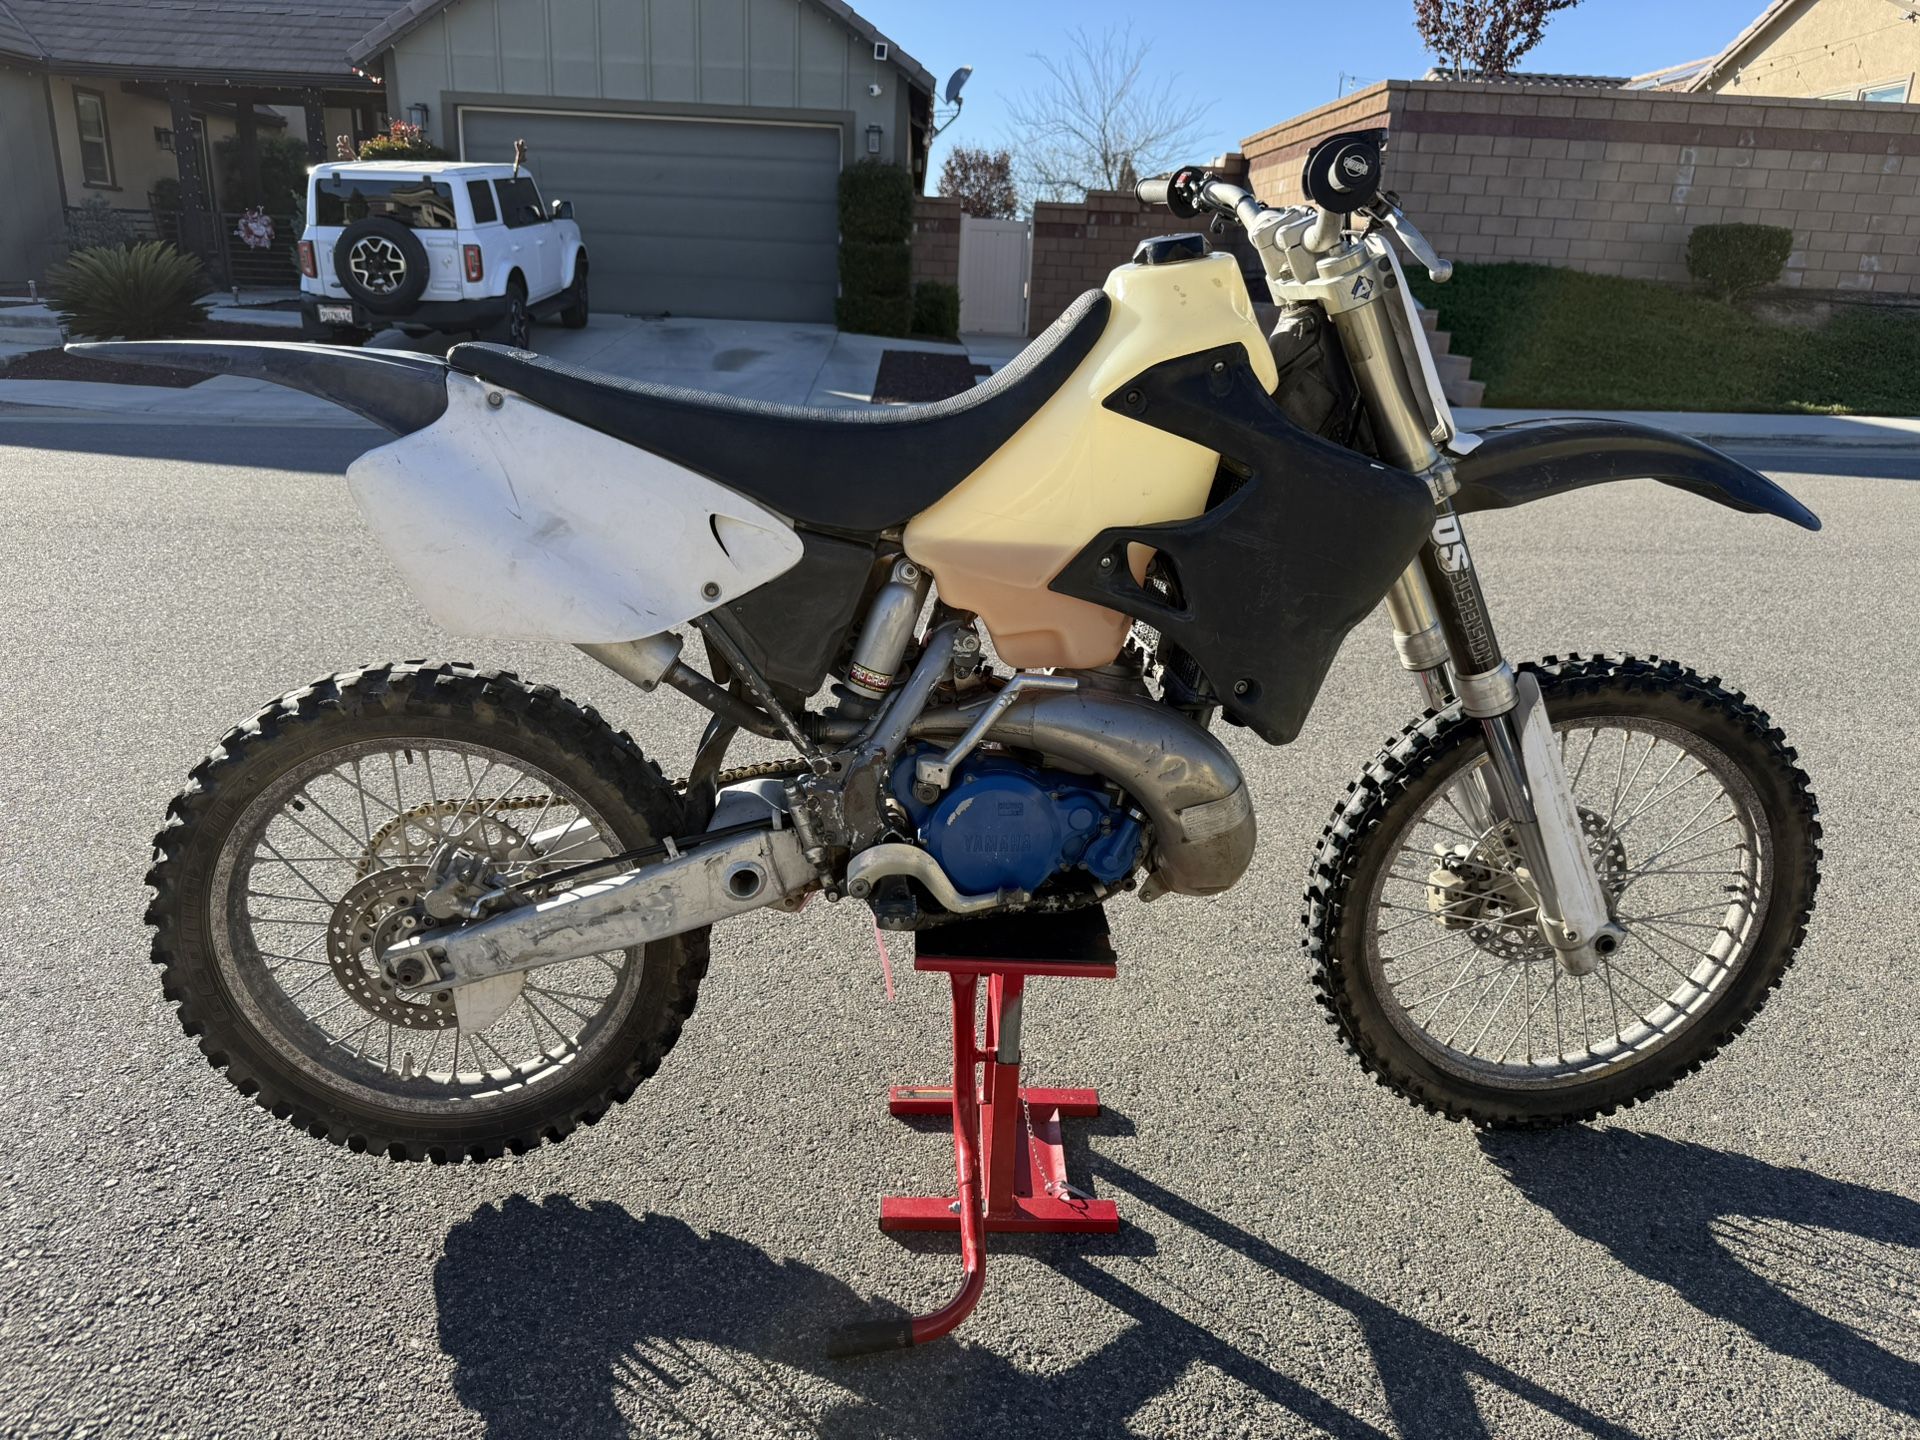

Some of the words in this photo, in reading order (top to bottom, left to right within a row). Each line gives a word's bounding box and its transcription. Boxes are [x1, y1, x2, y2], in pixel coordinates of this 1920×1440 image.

[1431, 514, 1470, 573] DS
[1450, 568, 1493, 664] SUSPENSION
[852, 664, 866, 679] PRO
[963, 834, 1031, 852] YAMAHA
